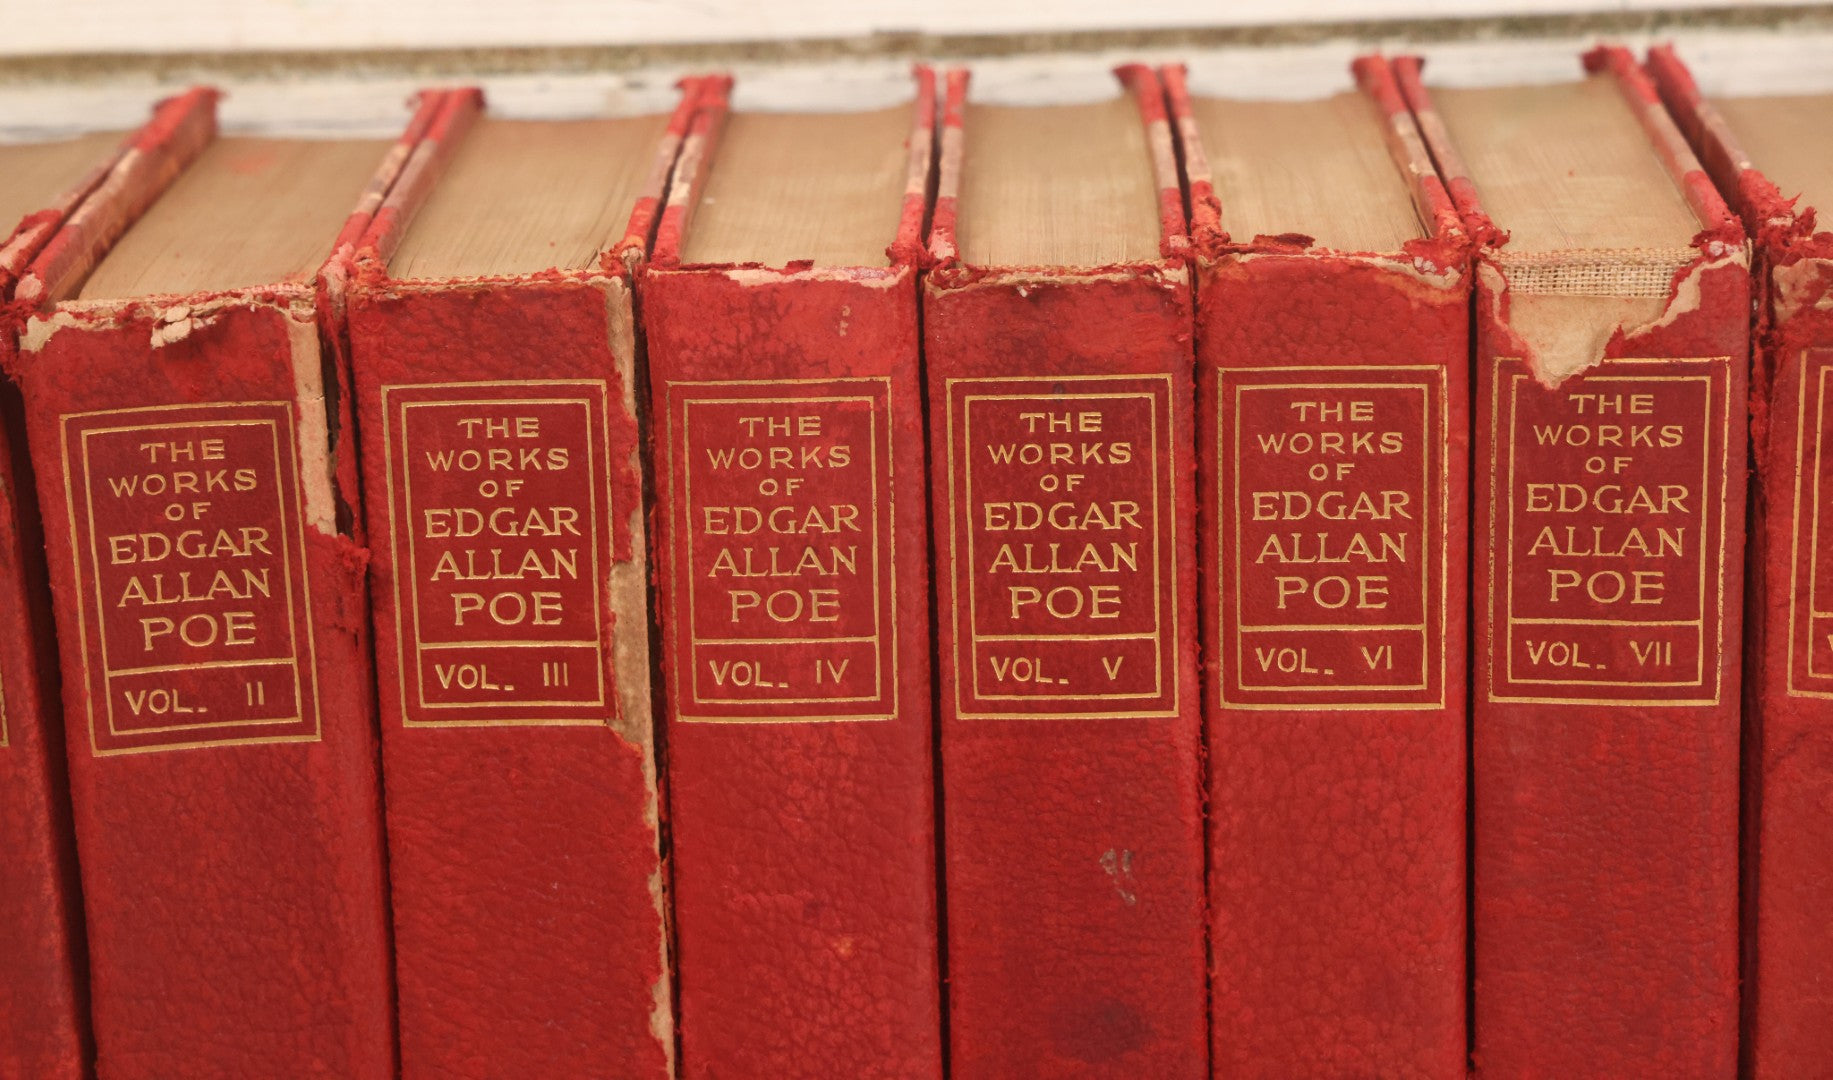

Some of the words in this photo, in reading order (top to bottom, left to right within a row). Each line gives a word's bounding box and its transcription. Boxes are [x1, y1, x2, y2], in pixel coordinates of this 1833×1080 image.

[1290, 400, 1374, 423] THE
[1568, 393, 1654, 415] THE
[457, 416, 540, 439] THE
[738, 415, 821, 438] THE
[1019, 411, 1103, 434] THE
[1532, 424, 1684, 448] WORKS
[139, 438, 226, 464] THE
[706, 445, 851, 470] WORKS
[986, 441, 1132, 465] WORKS
[1256, 431, 1403, 455] WORKS
[425, 447, 570, 472] WORKS
[1308, 462, 1356, 482] OF
[1584, 455, 1633, 475] OF
[107, 468, 257, 498] WORKS
[478, 479, 525, 499] OF
[758, 477, 805, 497] OF
[1039, 473, 1086, 493] OF
[164, 501, 212, 522] OF
[1251, 490, 1413, 521] EDGAR
[1525, 483, 1690, 515] EDGAR
[423, 506, 582, 539] EDGAR
[702, 503, 862, 536] EDGAR
[983, 500, 1143, 532] EDGAR
[108, 526, 273, 565] EDGAR
[1255, 532, 1408, 565] ALLAN
[1527, 525, 1685, 558] ALLAN
[429, 548, 578, 582] ALLAN
[707, 545, 857, 578] ALLAN
[988, 541, 1138, 574] ALLAN
[117, 568, 271, 608] ALLAN
[1007, 584, 1122, 620] POE
[1274, 575, 1389, 610] POE
[1547, 568, 1665, 605] POE
[450, 591, 564, 627] POE
[727, 588, 841, 623] POE
[138, 611, 257, 652] POE
[989, 656, 1070, 685] VOL.
[1101, 655, 1124, 681] V
[1254, 647, 1335, 676] VOL.
[1360, 644, 1393, 671] VI
[1525, 639, 1607, 670] VOL.
[1629, 640, 1672, 666] VII
[434, 663, 515, 692] VOL.
[542, 661, 569, 687] III
[708, 659, 789, 689] VOL.
[815, 658, 849, 685] IV
[124, 688, 208, 716] VOL.
[245, 681, 265, 707] II
